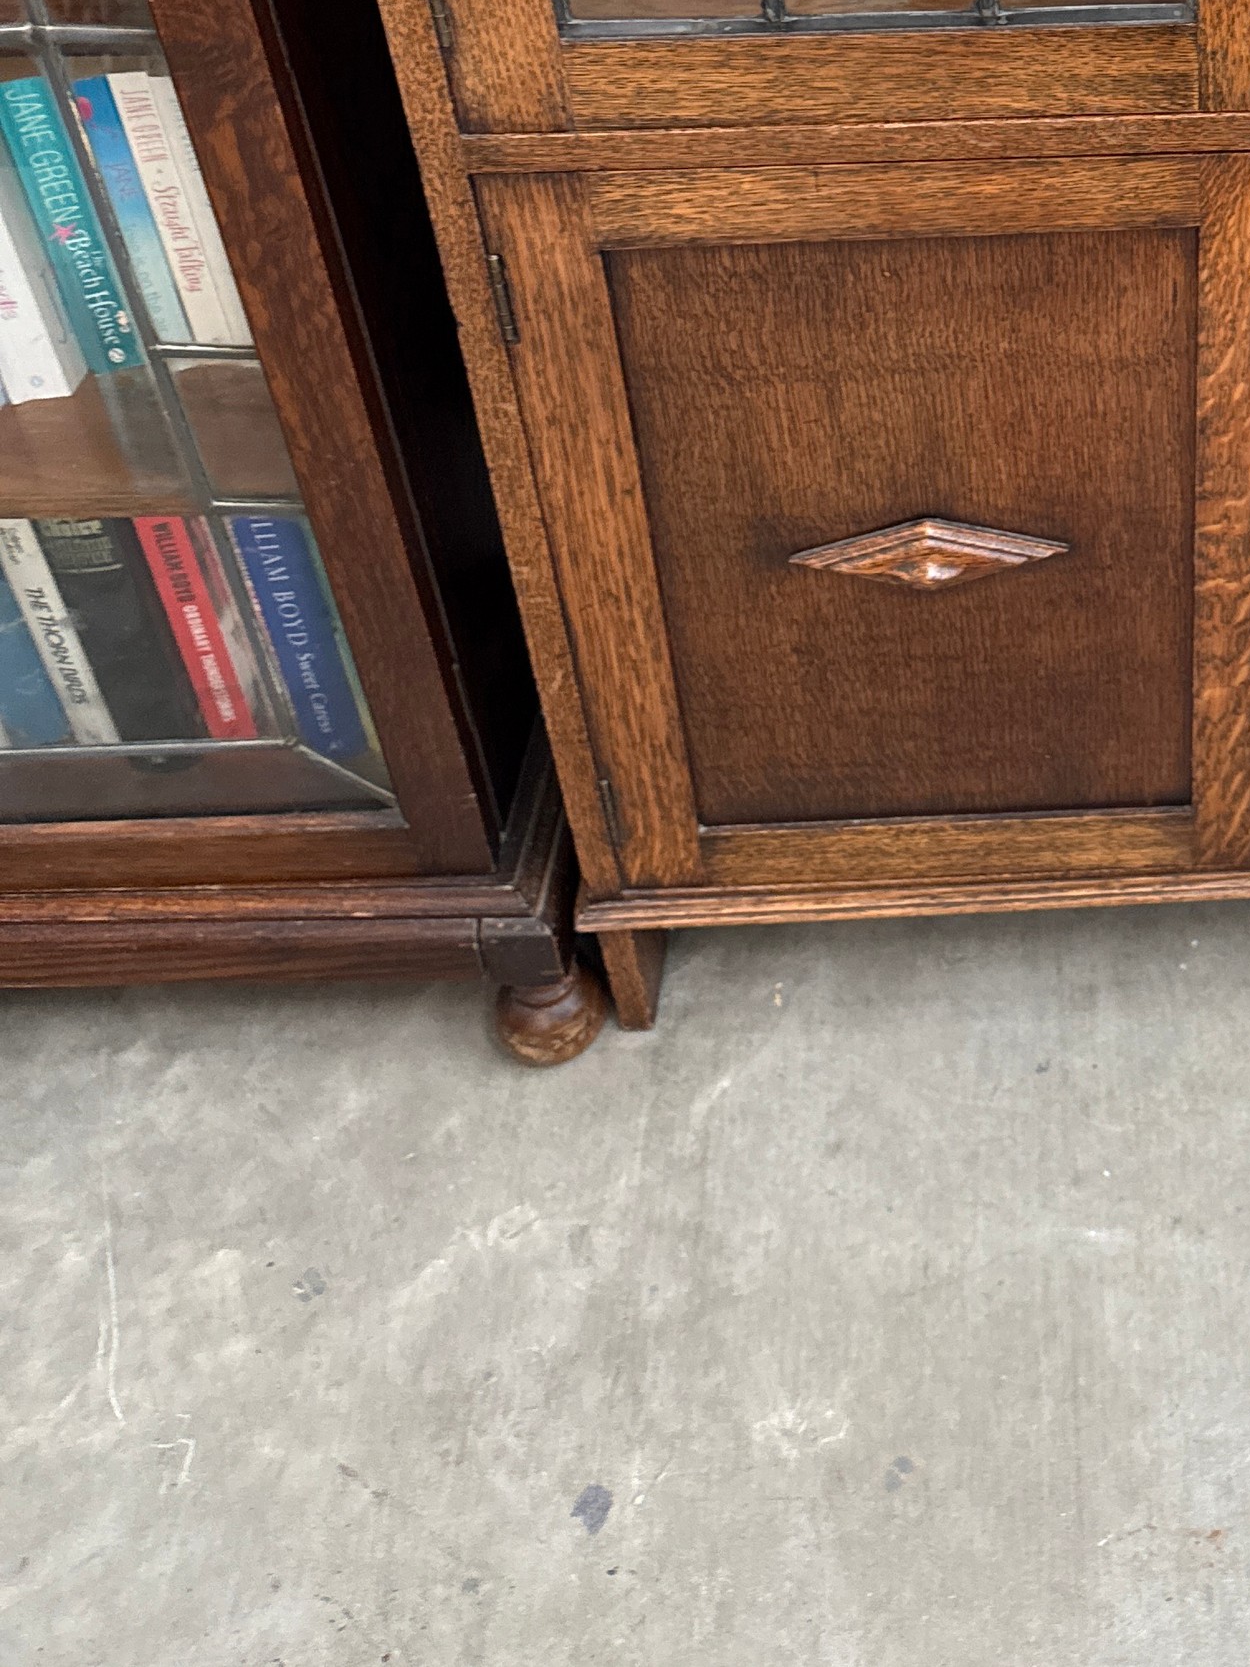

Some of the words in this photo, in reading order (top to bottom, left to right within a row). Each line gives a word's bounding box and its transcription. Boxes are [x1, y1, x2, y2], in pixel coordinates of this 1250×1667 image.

[5, 90, 57, 147] JANE
[120, 89, 156, 121] JANE
[131, 123, 169, 163] GREEN
[29, 150, 84, 224] GREEN
[151, 184, 192, 241] Straight
[65, 228, 105, 288] Beach
[174, 239, 205, 294] Talking
[84, 290, 121, 346] House
[271, 590, 309, 647] BOYD
[296, 652, 321, 691] Sweet
[309, 692, 335, 734] Caress
